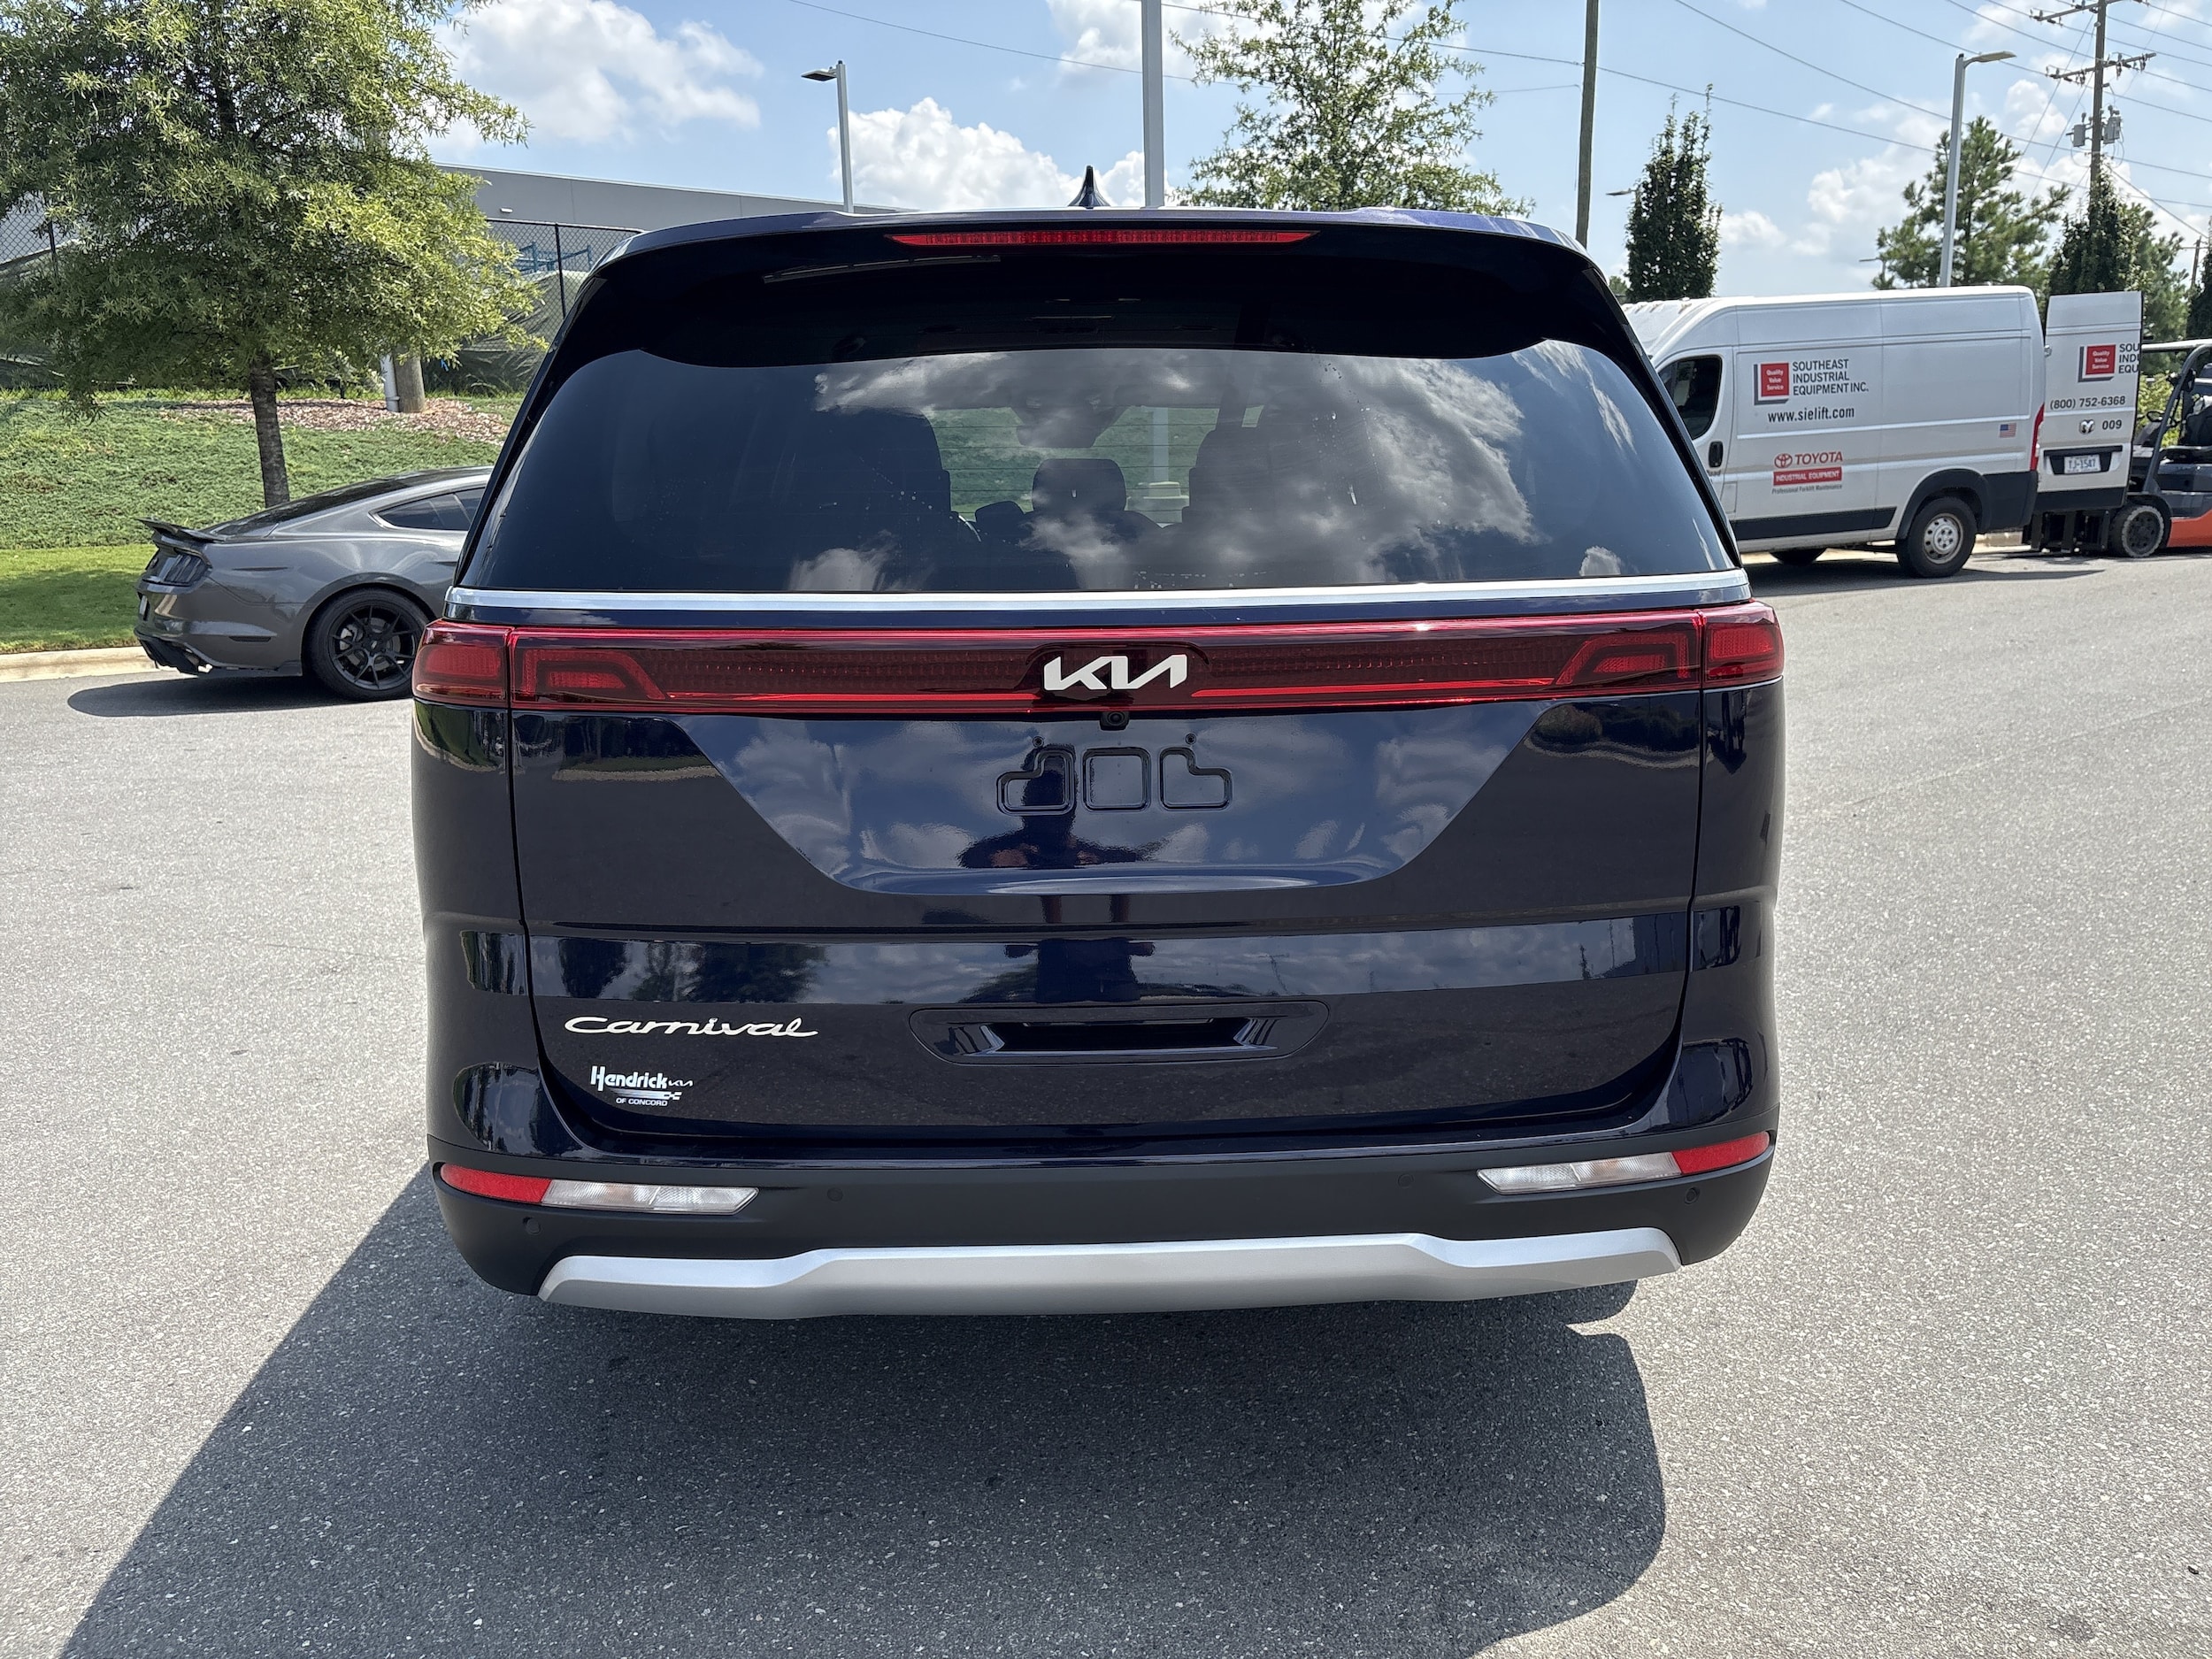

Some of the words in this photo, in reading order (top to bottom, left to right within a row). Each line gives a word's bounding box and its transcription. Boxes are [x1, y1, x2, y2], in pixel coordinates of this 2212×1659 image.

[1793, 359, 1849, 372] SOUTHEAST
[1793, 371, 1849, 383] INDUSTRIAL
[1793, 383, 1849, 396] EQUIPMENT
[1850, 382, 1869, 393] INC.
[2050, 399, 2076, 411] (800)
[2079, 396, 2125, 408] 752-6368
[1768, 407, 1855, 423] www.sielift.com
[2101, 419, 2122, 430] 009
[1794, 451, 1843, 465] TOYOTA
[1043, 654, 1187, 691] KIA
[565, 1016, 818, 1037] Carnival
[590, 1065, 667, 1092] Hendrick
